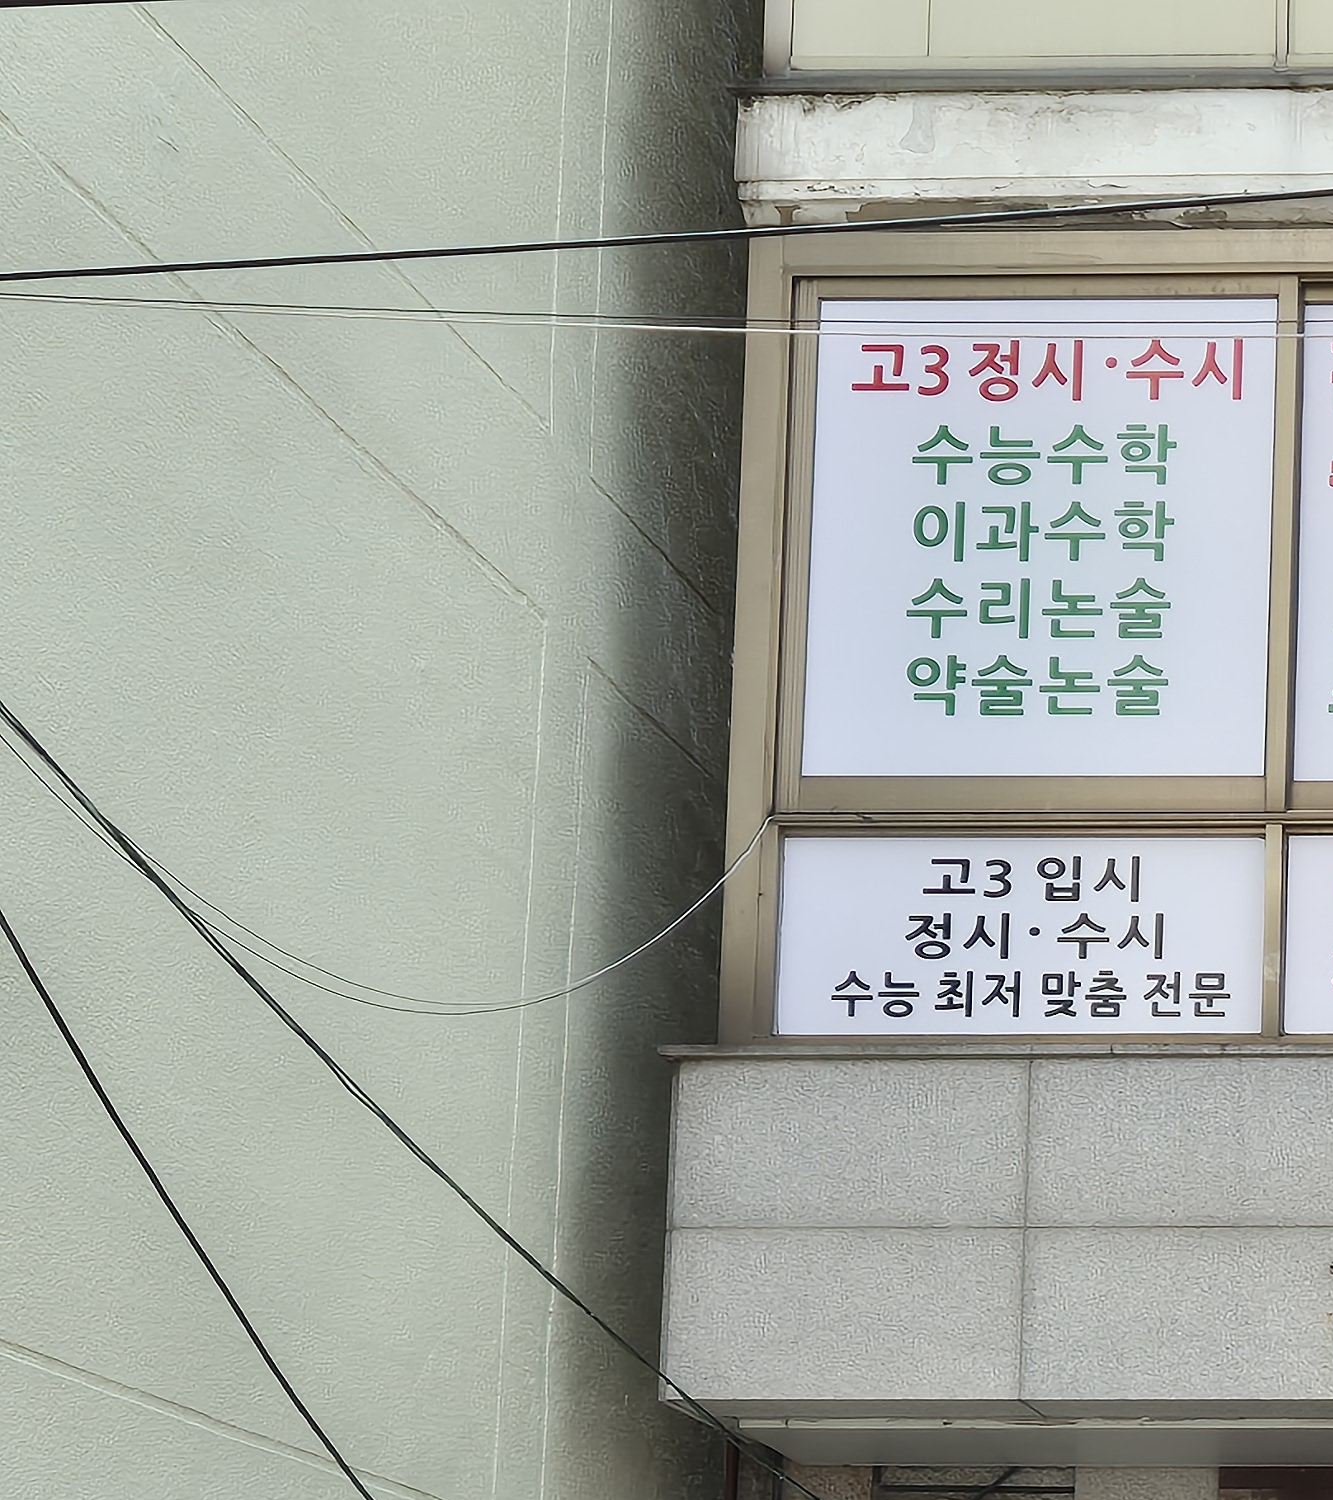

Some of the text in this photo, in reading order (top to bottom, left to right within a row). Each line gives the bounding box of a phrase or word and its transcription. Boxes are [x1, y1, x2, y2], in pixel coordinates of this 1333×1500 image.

[852, 345, 949, 396] 고3
[912, 425, 1177, 485] 수능수학
[914, 501, 1174, 562] 이과수학
[906, 578, 1171, 639] 수리논술
[907, 655, 1168, 716] 약술논술
[923, 856, 1140, 902] 고3 입시
[831, 971, 1230, 1017] 수능 최저 맞춤 전문
